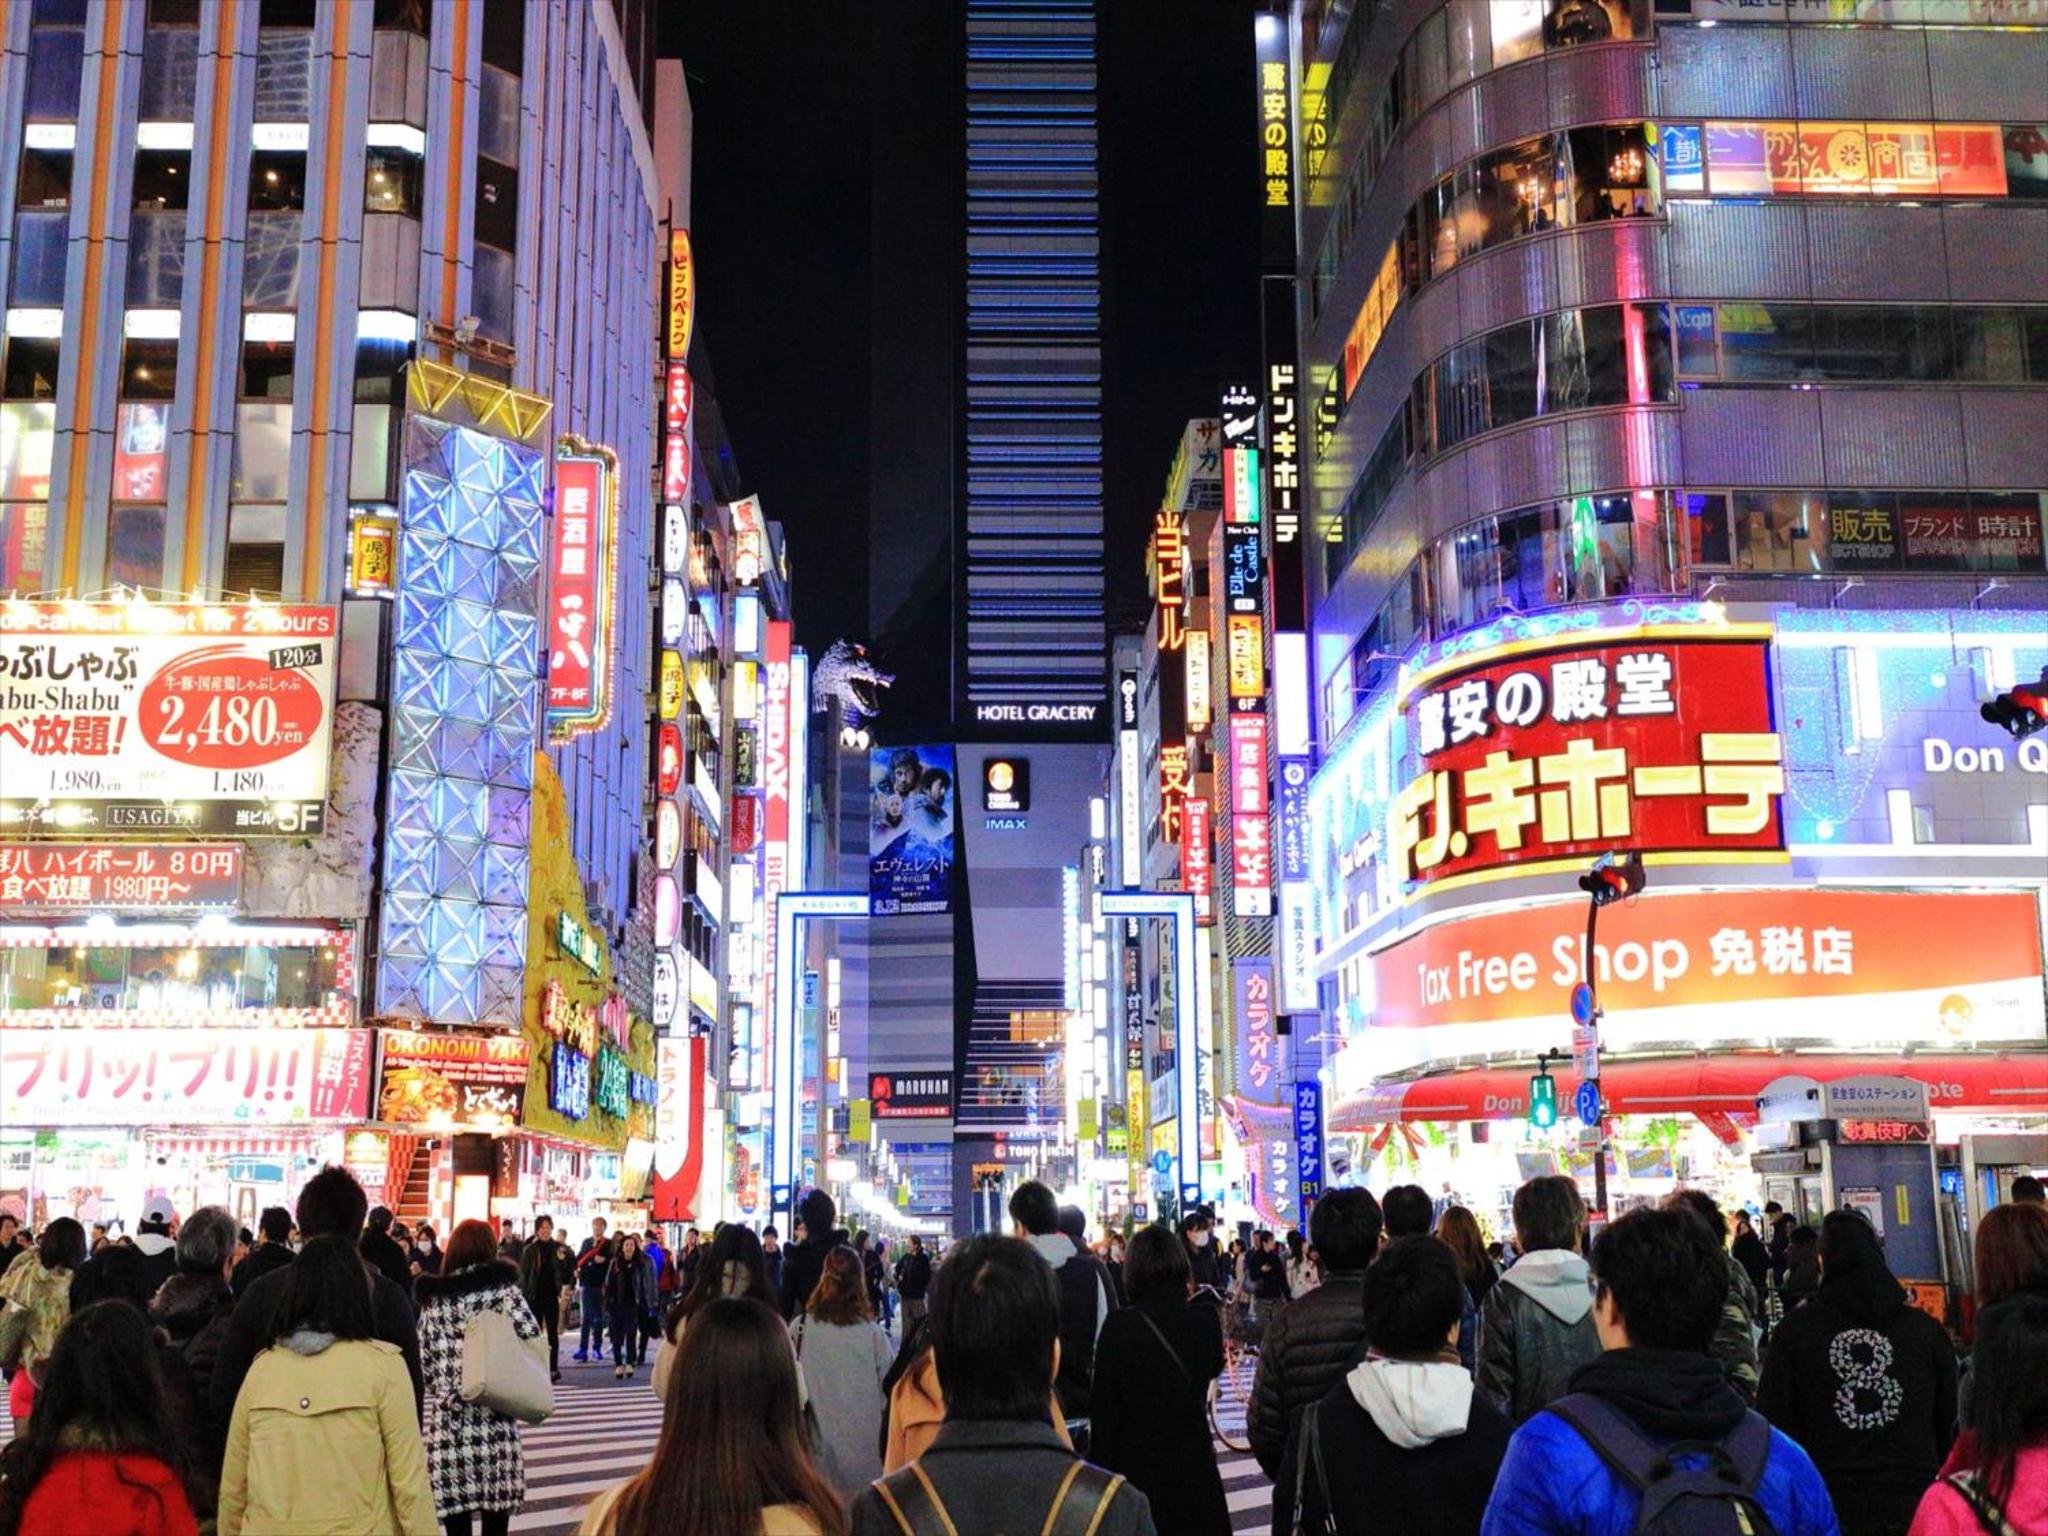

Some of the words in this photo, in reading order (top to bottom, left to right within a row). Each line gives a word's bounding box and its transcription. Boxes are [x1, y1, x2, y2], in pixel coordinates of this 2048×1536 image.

[1263, 63, 1290, 206] 驚安の殿堂
[1832, 511, 1894, 542] 販売
[1905, 516, 1966, 537] ブランド
[1978, 516, 2038, 538] 時計
[1244, 537, 1259, 583] Castle
[264, 611, 331, 632] ours
[272, 646, 317, 670] 120分
[977, 706, 1025, 721] HOTEL
[1028, 706, 1097, 721] GRACERY
[1238, 699, 1257, 711] 6F
[1417, 652, 1675, 755] 驚安の殿堂
[1923, 737, 2004, 773] Don
[113, 806, 198, 826] USAGIYA
[986, 819, 1026, 830] IMAX
[44, 849, 155, 874] ハイボール
[874, 855, 950, 874] エヴェレスト
[2, 875, 92, 900] 食べ放題
[1709, 925, 1854, 978] 免税店
[1419, 964, 1452, 1007] Tax
[1458, 949, 1538, 999] Free
[1552, 934, 1690, 997] Shop
[1246, 973, 1272, 1088] カラオケ
[386, 1034, 481, 1060] OKONOMI
[487, 1036, 531, 1062] YAKI
[896, 1080, 949, 1096] MARUHAN
[1484, 1095, 1522, 1112] Don
[1299, 1087, 1320, 1176] カラオケ
[1829, 1328, 1904, 1429] 8
